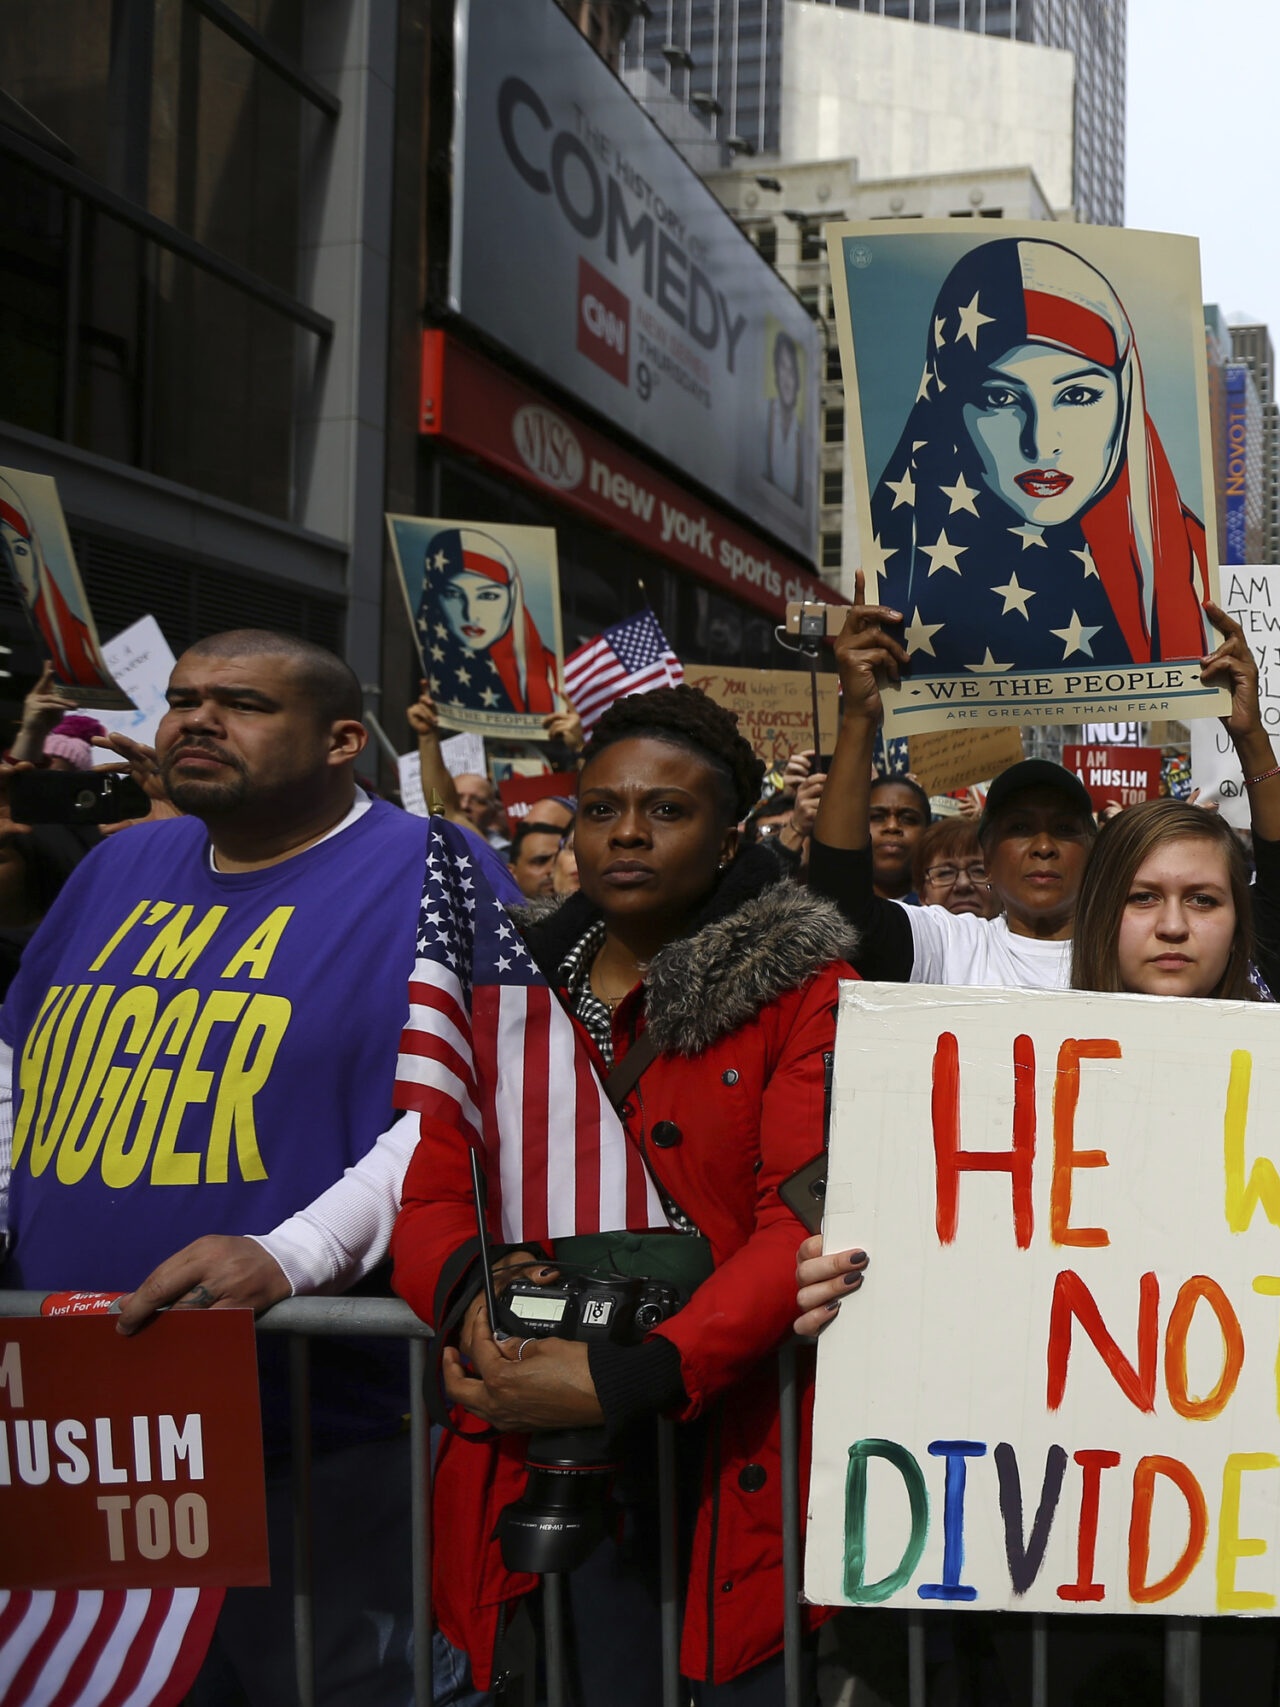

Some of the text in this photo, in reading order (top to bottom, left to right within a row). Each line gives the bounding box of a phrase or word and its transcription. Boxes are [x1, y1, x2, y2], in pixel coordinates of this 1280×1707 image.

[497, 76, 747, 375] COMEDY
[615, 150, 687, 241] HISTORY
[582, 293, 626, 356] CNN
[522, 411, 578, 484] NYSC
[589, 459, 655, 523] new
[660, 503, 715, 558] york
[719, 538, 782, 598] sports
[1228, 574, 1271, 607] AM
[925, 670, 1185, 700] WE THE PEOPLE
[946, 702, 1170, 720] ARE GREATER THAN FEAR
[485, 714, 542, 725] PEOPLE
[1075, 750, 1107, 767] I AM
[1090, 769, 1147, 788] MUSLIM
[1120, 789, 1147, 805] TOO
[88, 899, 295, 980] I'M A
[11, 984, 293, 1189] HUGGER
[930, 1031, 1122, 1250] HE
[49, 1305, 71, 1317] Just
[73, 1303, 92, 1313] For
[0, 1413, 205, 1486] USLIM
[97, 1493, 209, 1561] TOO
